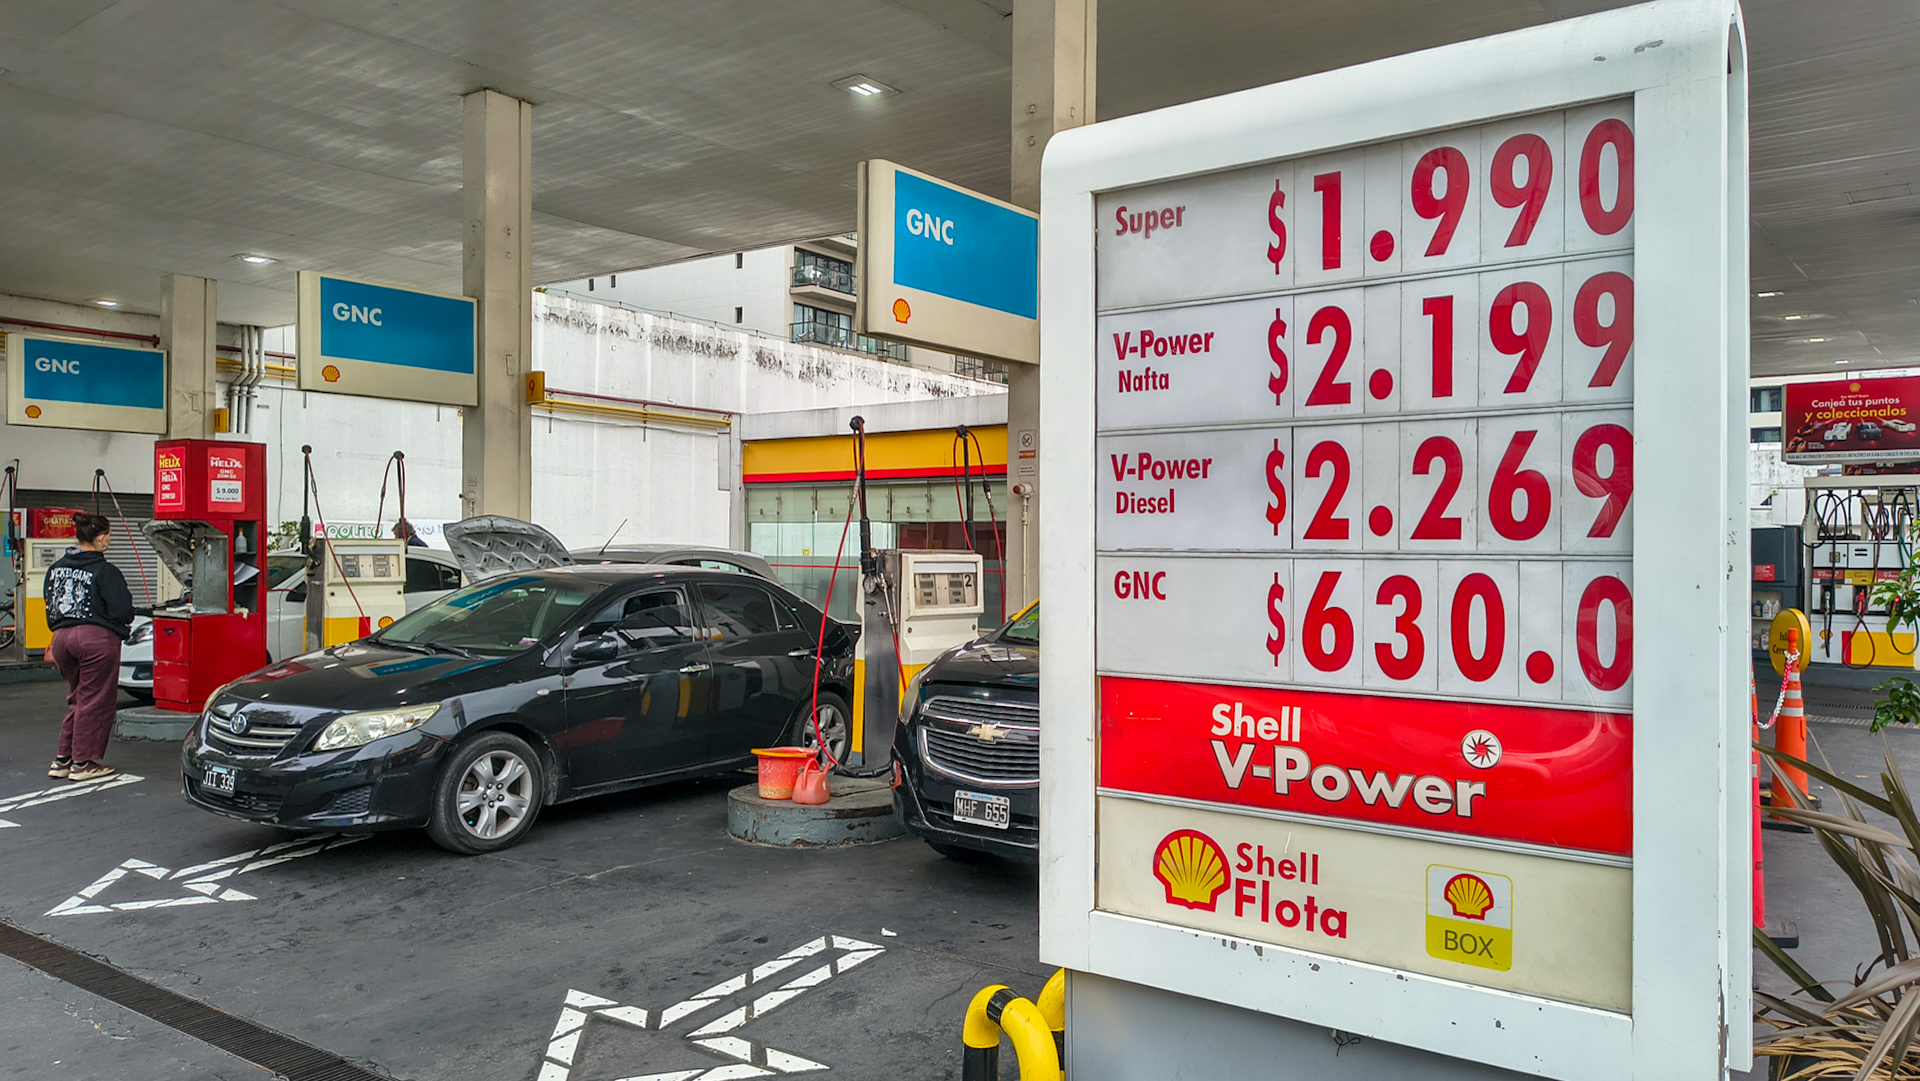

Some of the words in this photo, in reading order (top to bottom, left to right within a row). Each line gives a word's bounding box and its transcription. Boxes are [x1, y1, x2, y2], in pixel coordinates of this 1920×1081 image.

[1266, 179, 1287, 275] $
[1313, 118, 1634, 271] 1.990
[906, 208, 954, 245] GNC
[1116, 205, 1186, 239] Super
[333, 302, 382, 327] GNC
[1113, 329, 1214, 361] V-Power
[1267, 308, 1289, 406] $
[1306, 271, 1634, 406] 2.199
[35, 357, 80, 375] GNC
[1118, 366, 1169, 393] Nafta
[1848, 398, 1863, 407] tus
[1865, 396, 1900, 407] puntos
[1805, 412, 1813, 423] y
[159, 456, 181, 468] HELIX
[211, 458, 243, 468] HELIX
[1111, 452, 1213, 482] V-Power
[1265, 438, 1287, 536] $
[1302, 423, 1634, 541] 2.269
[1116, 488, 1175, 514] Diesel
[964, 574, 972, 588] 2
[1114, 570, 1167, 601] GNC
[1266, 572, 1286, 667] $
[1302, 571, 1634, 692] 630.0
[1210, 702, 1302, 743] Shell
[219, 774, 235, 791] 339
[1208, 738, 1487, 819] V-Power
[956, 798, 978, 817] MHF
[984, 803, 1007, 823] 655
[1235, 842, 1319, 886] Shell
[1234, 877, 1348, 939] Flota
[1443, 929, 1495, 959] BOX
